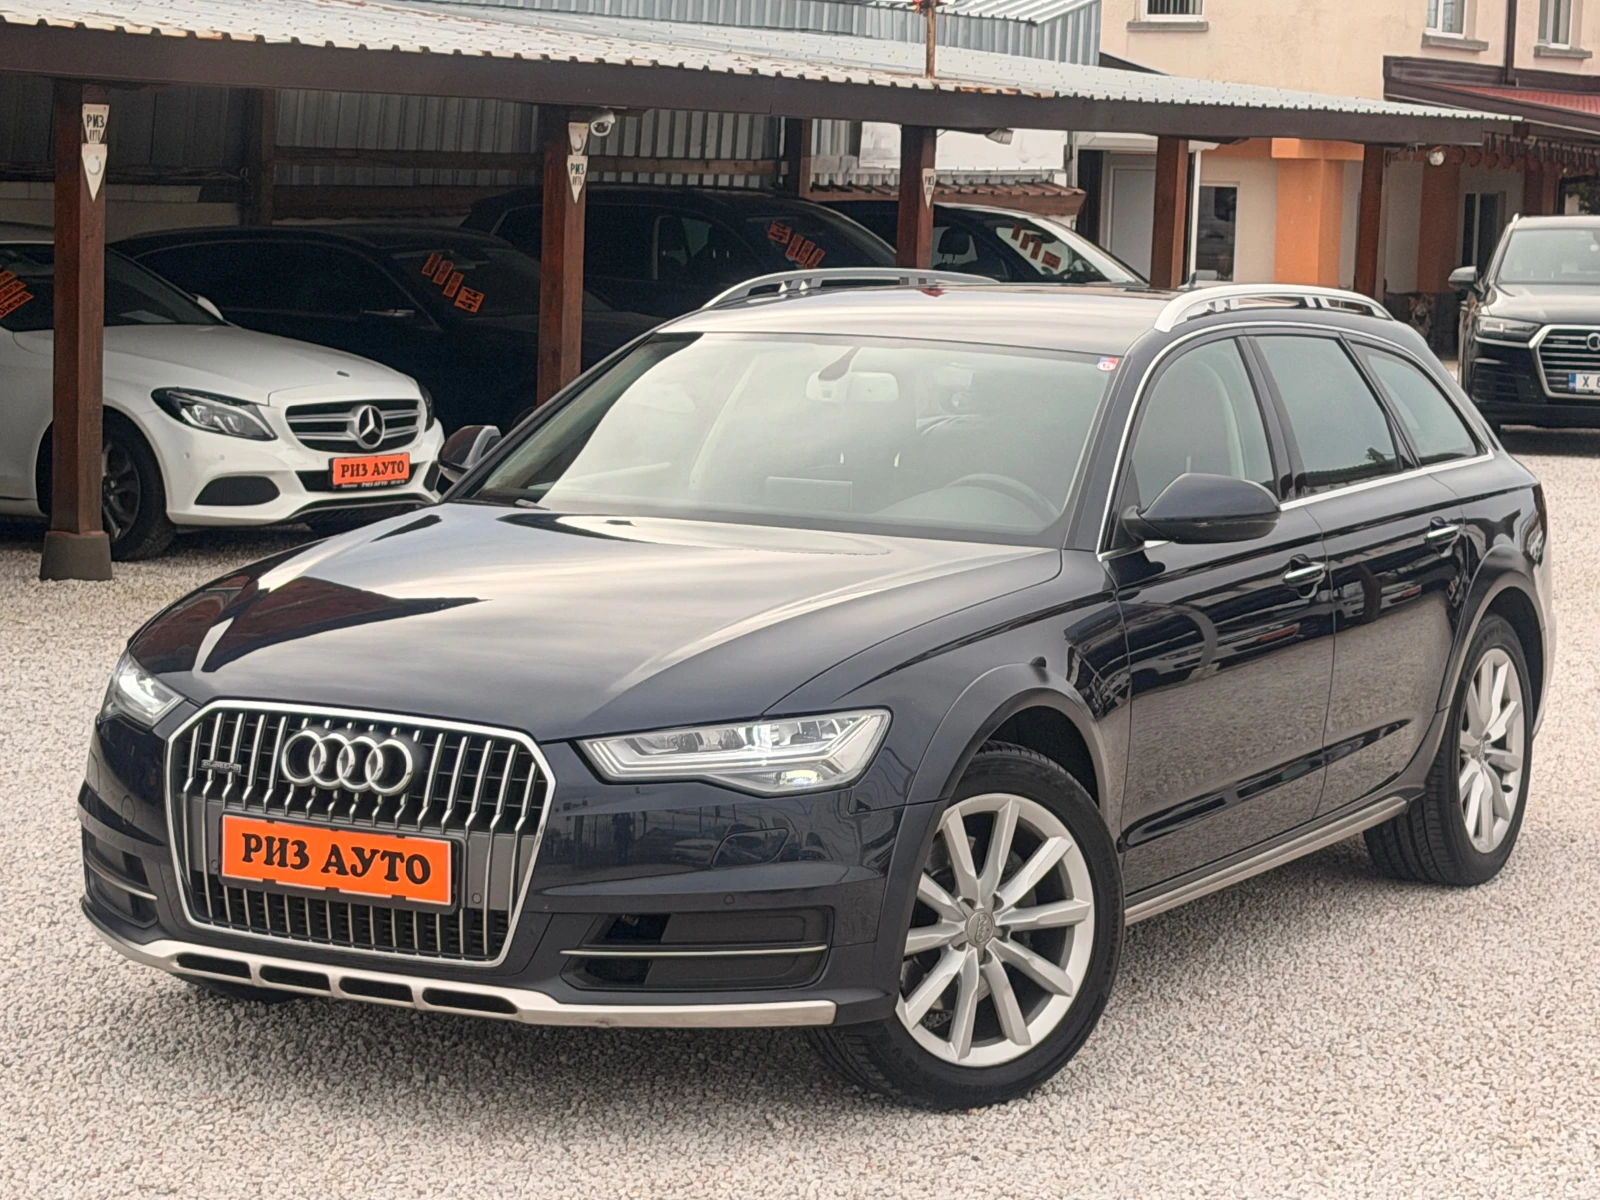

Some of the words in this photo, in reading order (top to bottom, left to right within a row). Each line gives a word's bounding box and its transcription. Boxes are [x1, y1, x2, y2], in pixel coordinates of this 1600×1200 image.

[86, 113, 105, 128] РИЗ
[340, 464, 368, 478] РИЗ
[371, 460, 405, 476] АУТО
[242, 833, 310, 870] РИЗ
[321, 844, 431, 885] АУТО
